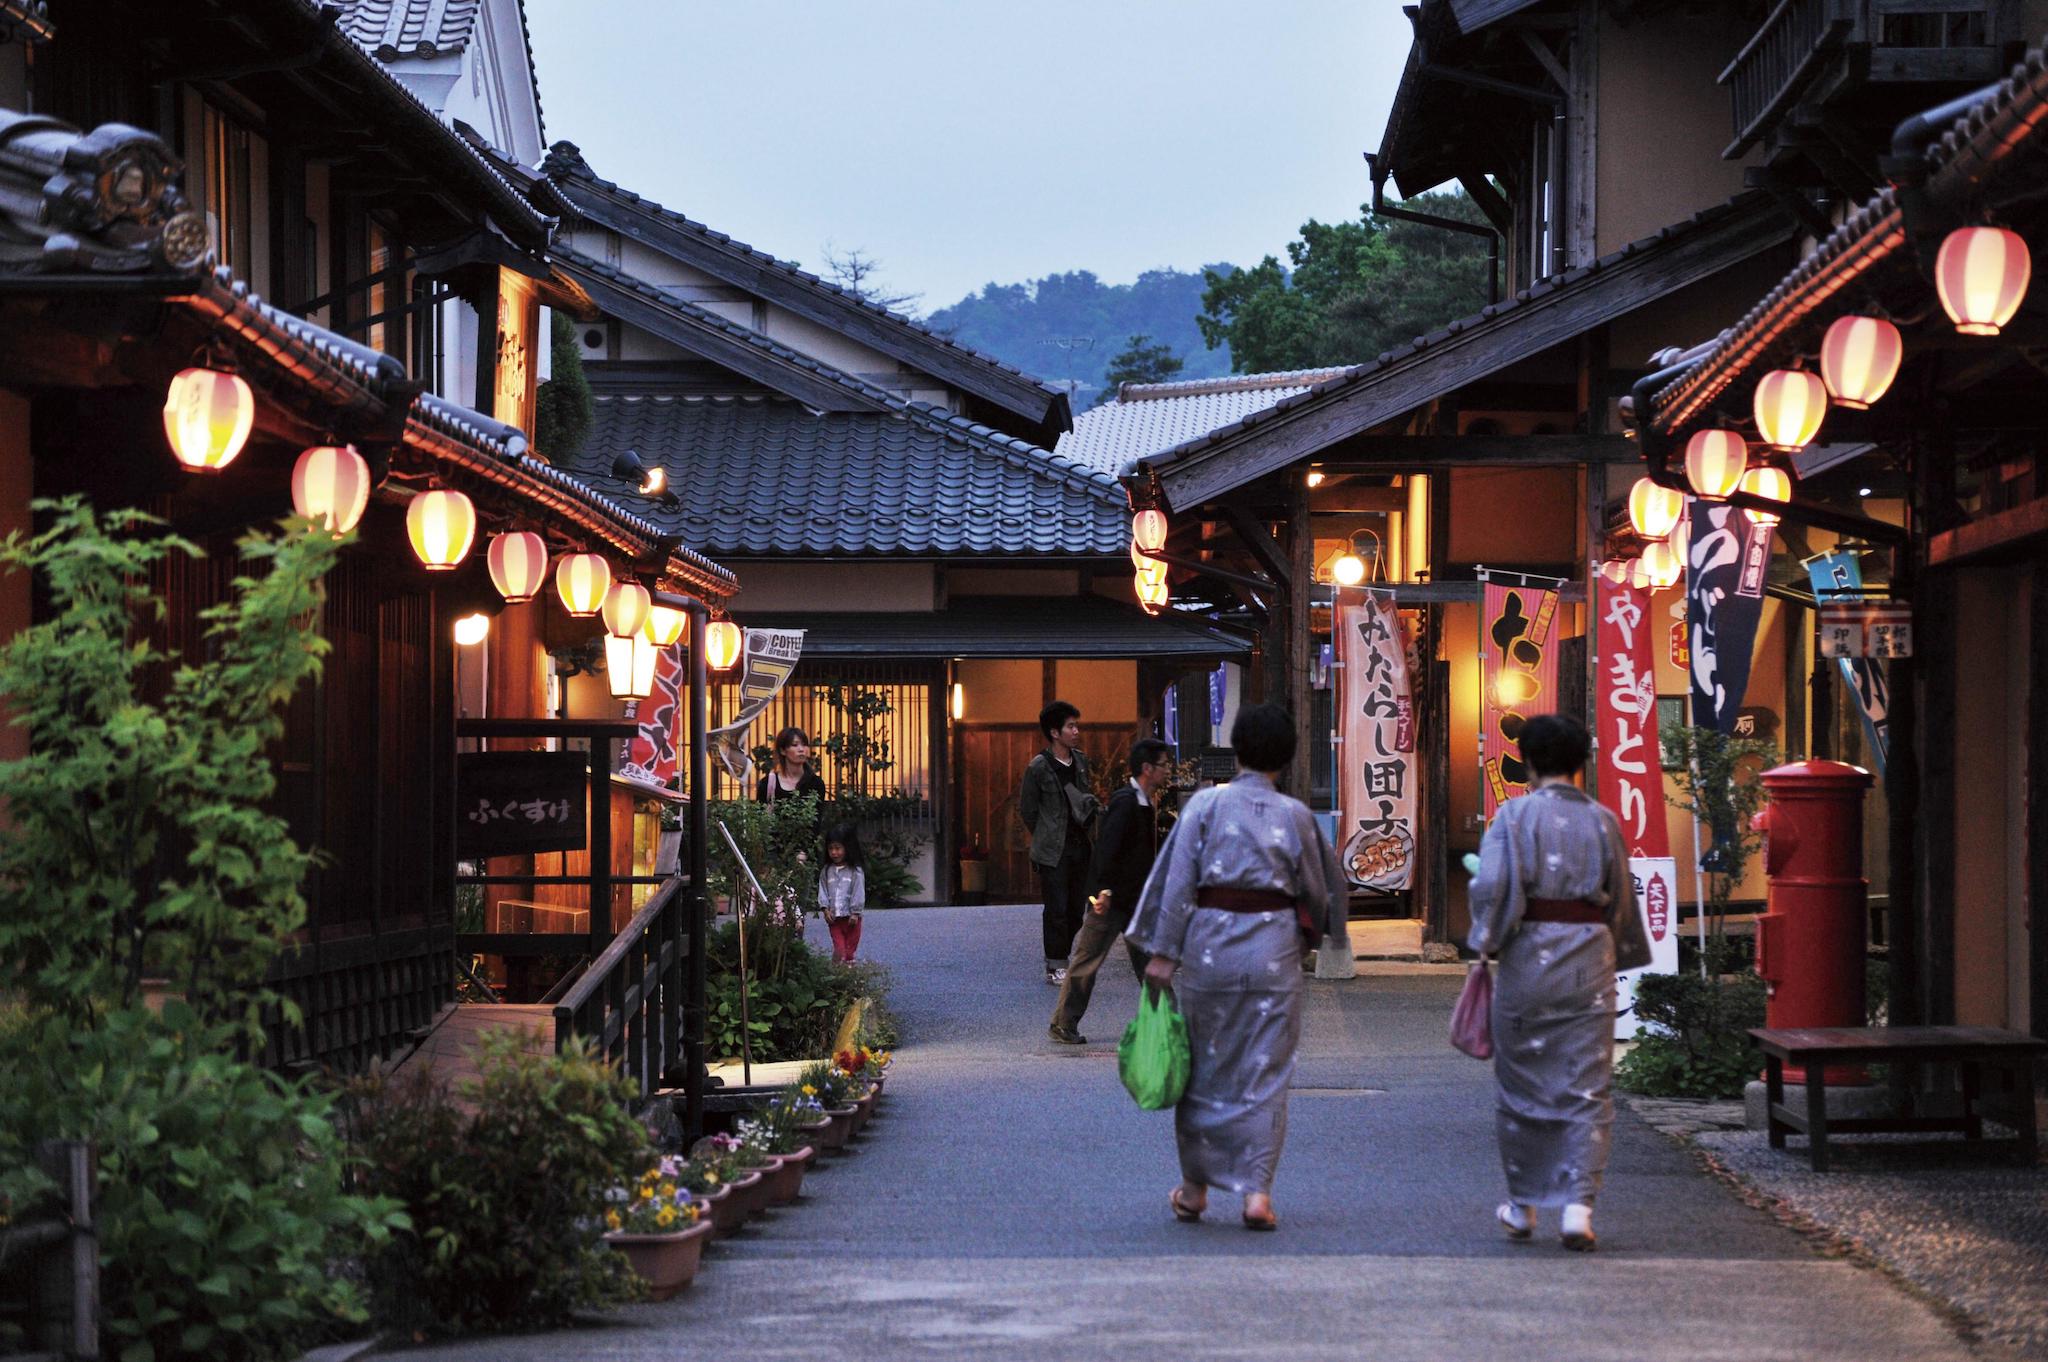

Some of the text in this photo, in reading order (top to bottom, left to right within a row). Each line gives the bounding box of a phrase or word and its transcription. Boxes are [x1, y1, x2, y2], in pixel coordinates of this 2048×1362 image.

[468, 797, 572, 825] ふくすけ
[1357, 598, 1408, 837] みたらし団子
[1604, 590, 1647, 840] やきとり
